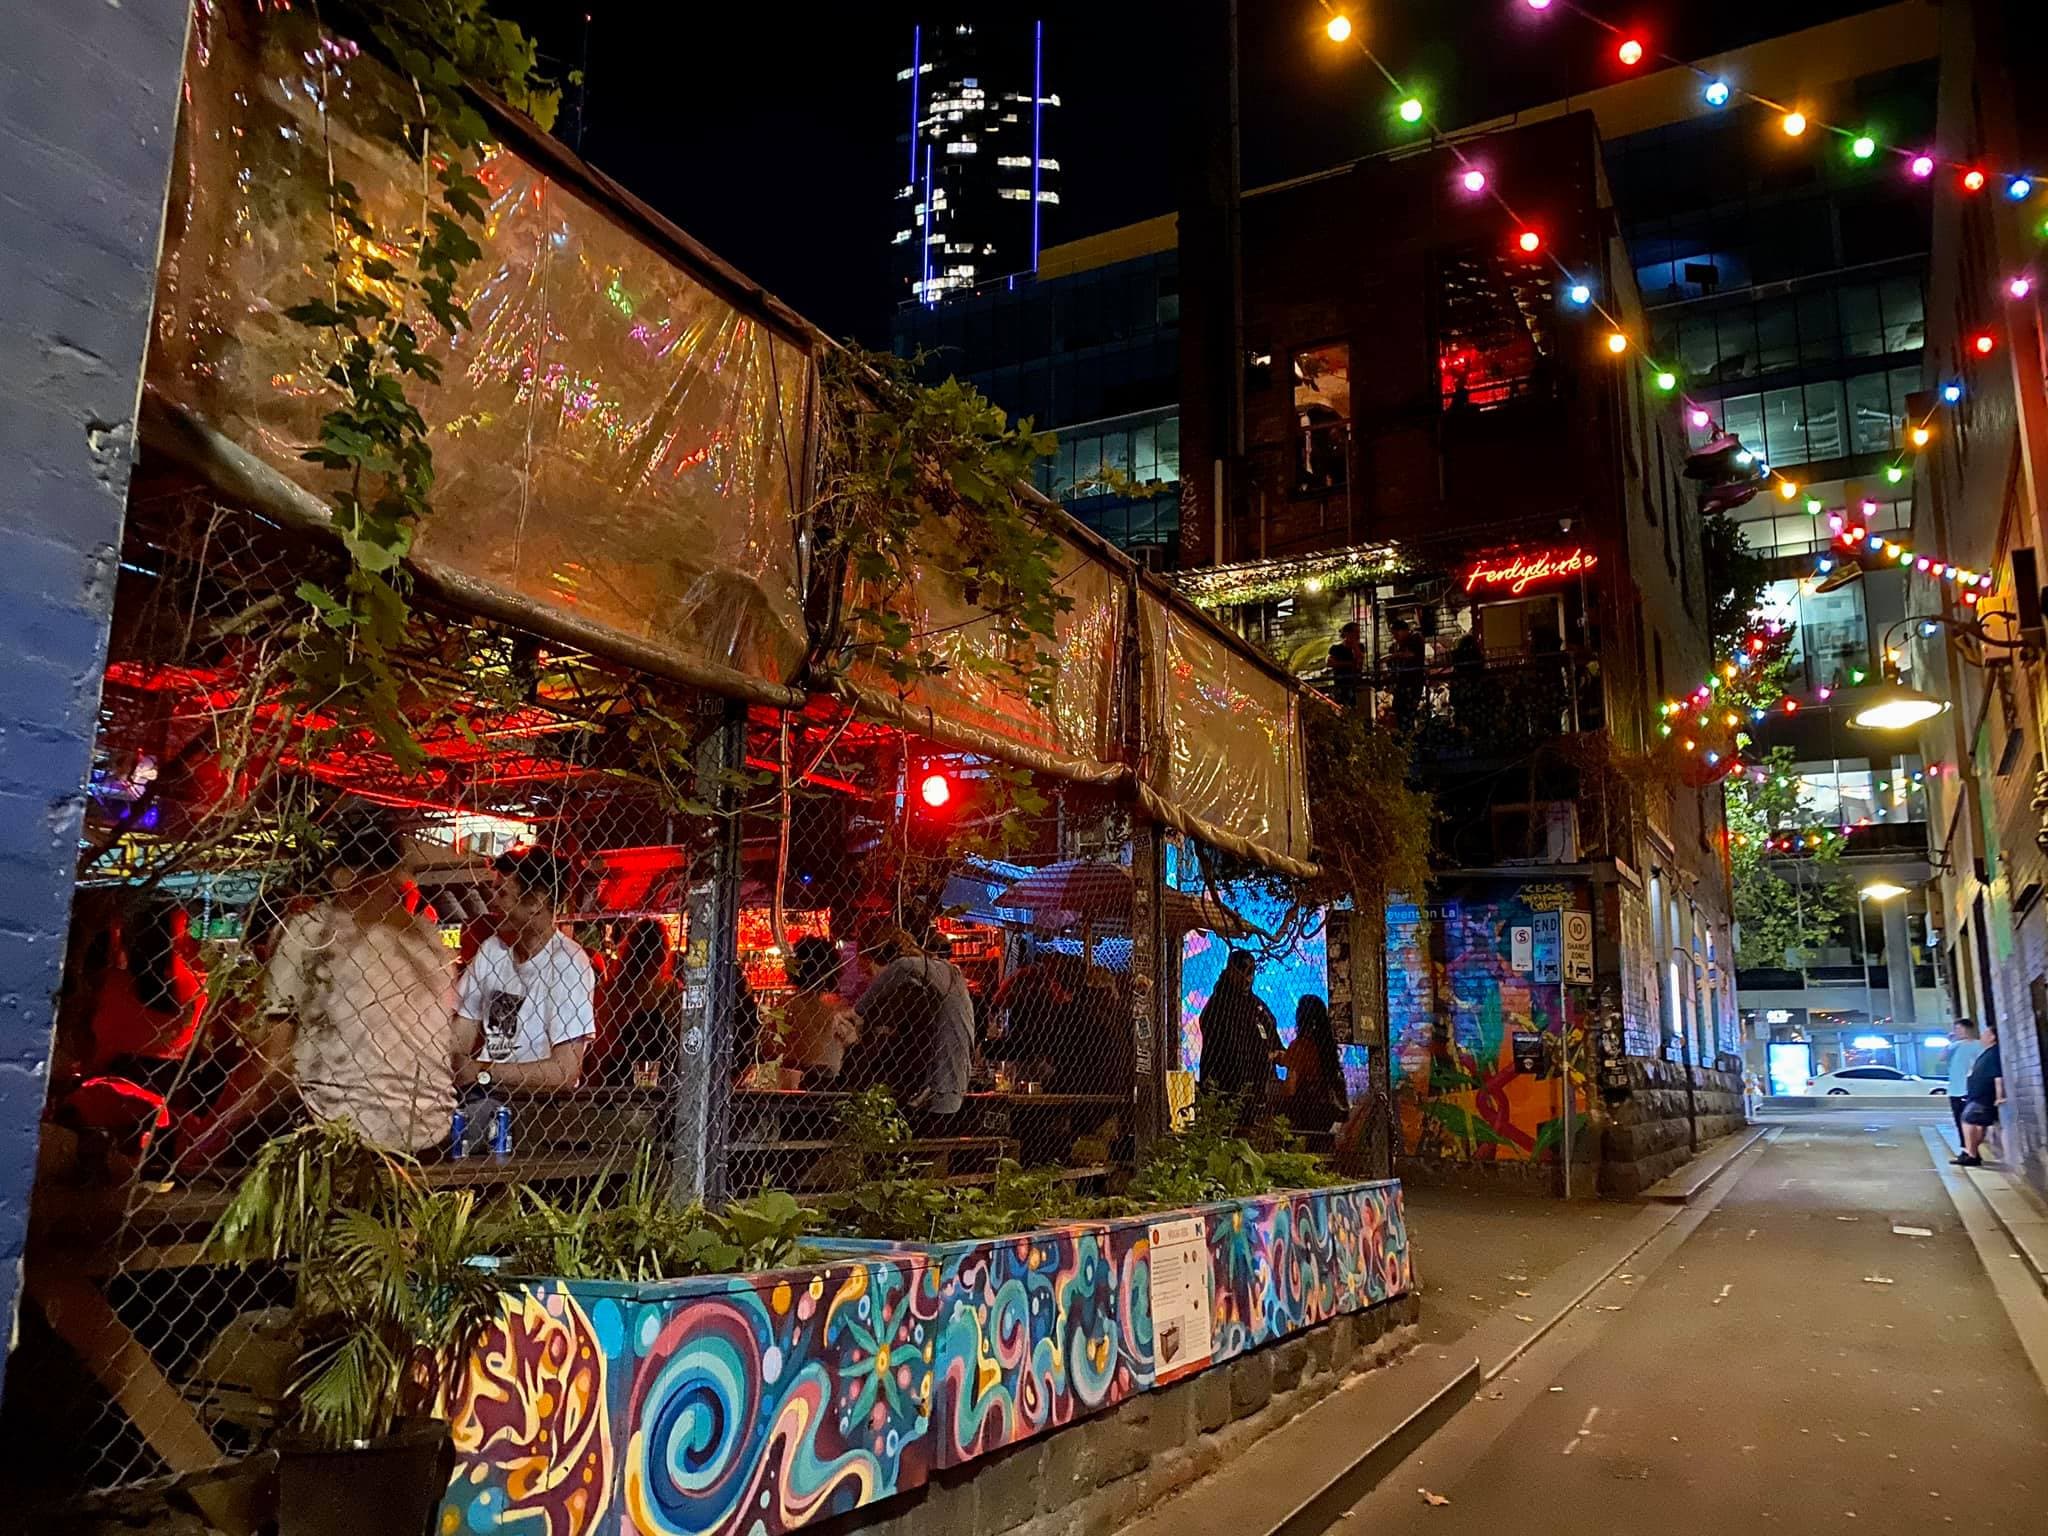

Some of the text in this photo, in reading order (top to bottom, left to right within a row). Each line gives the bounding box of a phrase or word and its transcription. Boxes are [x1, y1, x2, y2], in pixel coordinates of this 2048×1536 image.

[1441, 907, 1456, 918] La
[1535, 918, 1557, 932] END
[1573, 923, 1582, 934] 10
[1567, 943, 1590, 951] SHARED
[1571, 951, 1586, 960] ZONE
